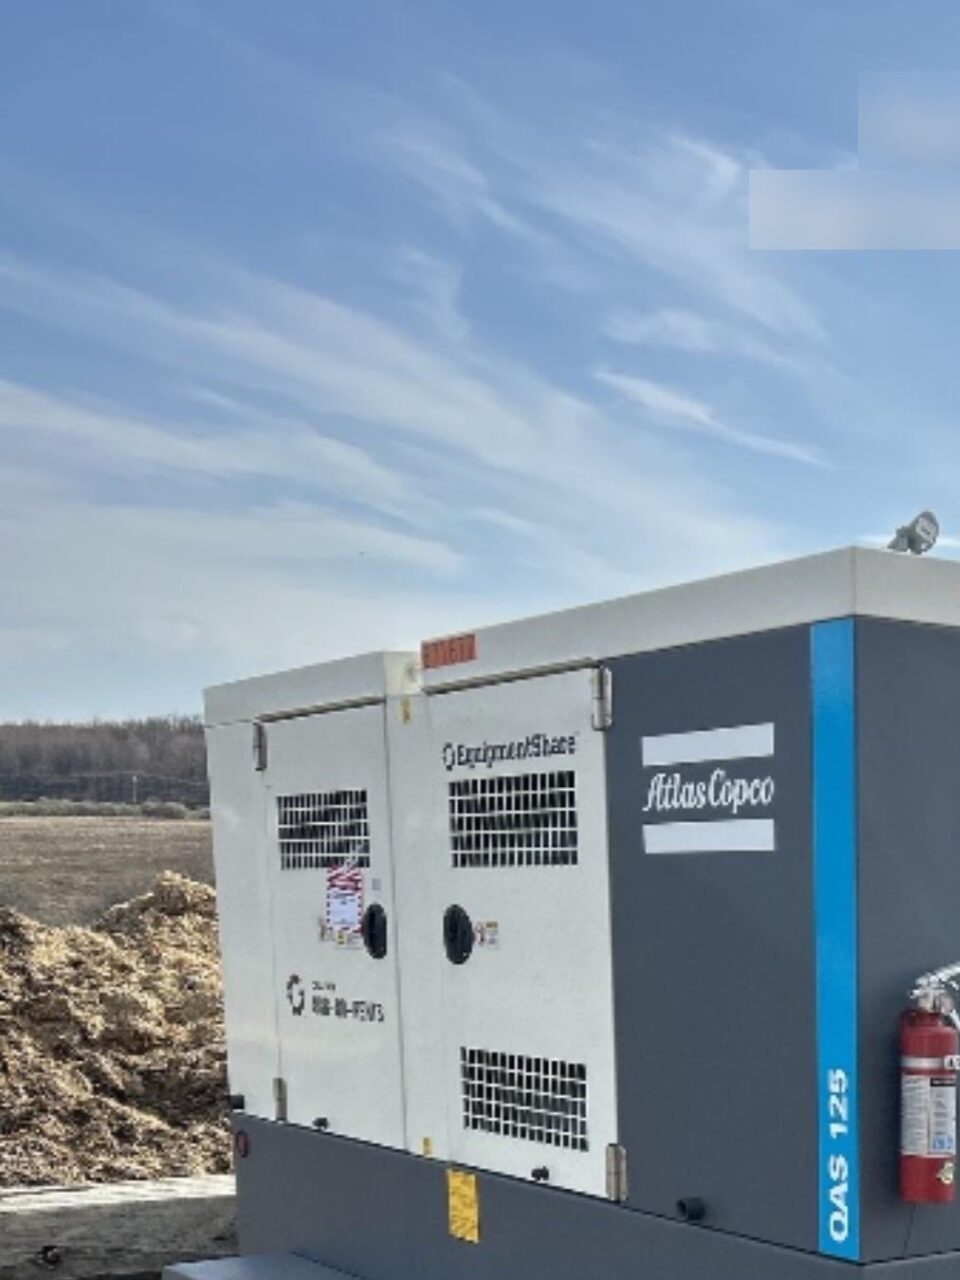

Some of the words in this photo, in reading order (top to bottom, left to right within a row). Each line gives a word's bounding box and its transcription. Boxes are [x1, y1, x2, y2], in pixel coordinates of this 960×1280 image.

[642, 773, 706, 811] Atlas
[708, 767, 775, 814] Copco
[827, 1068, 849, 1139] 125
[828, 1154, 849, 1243] QAS
